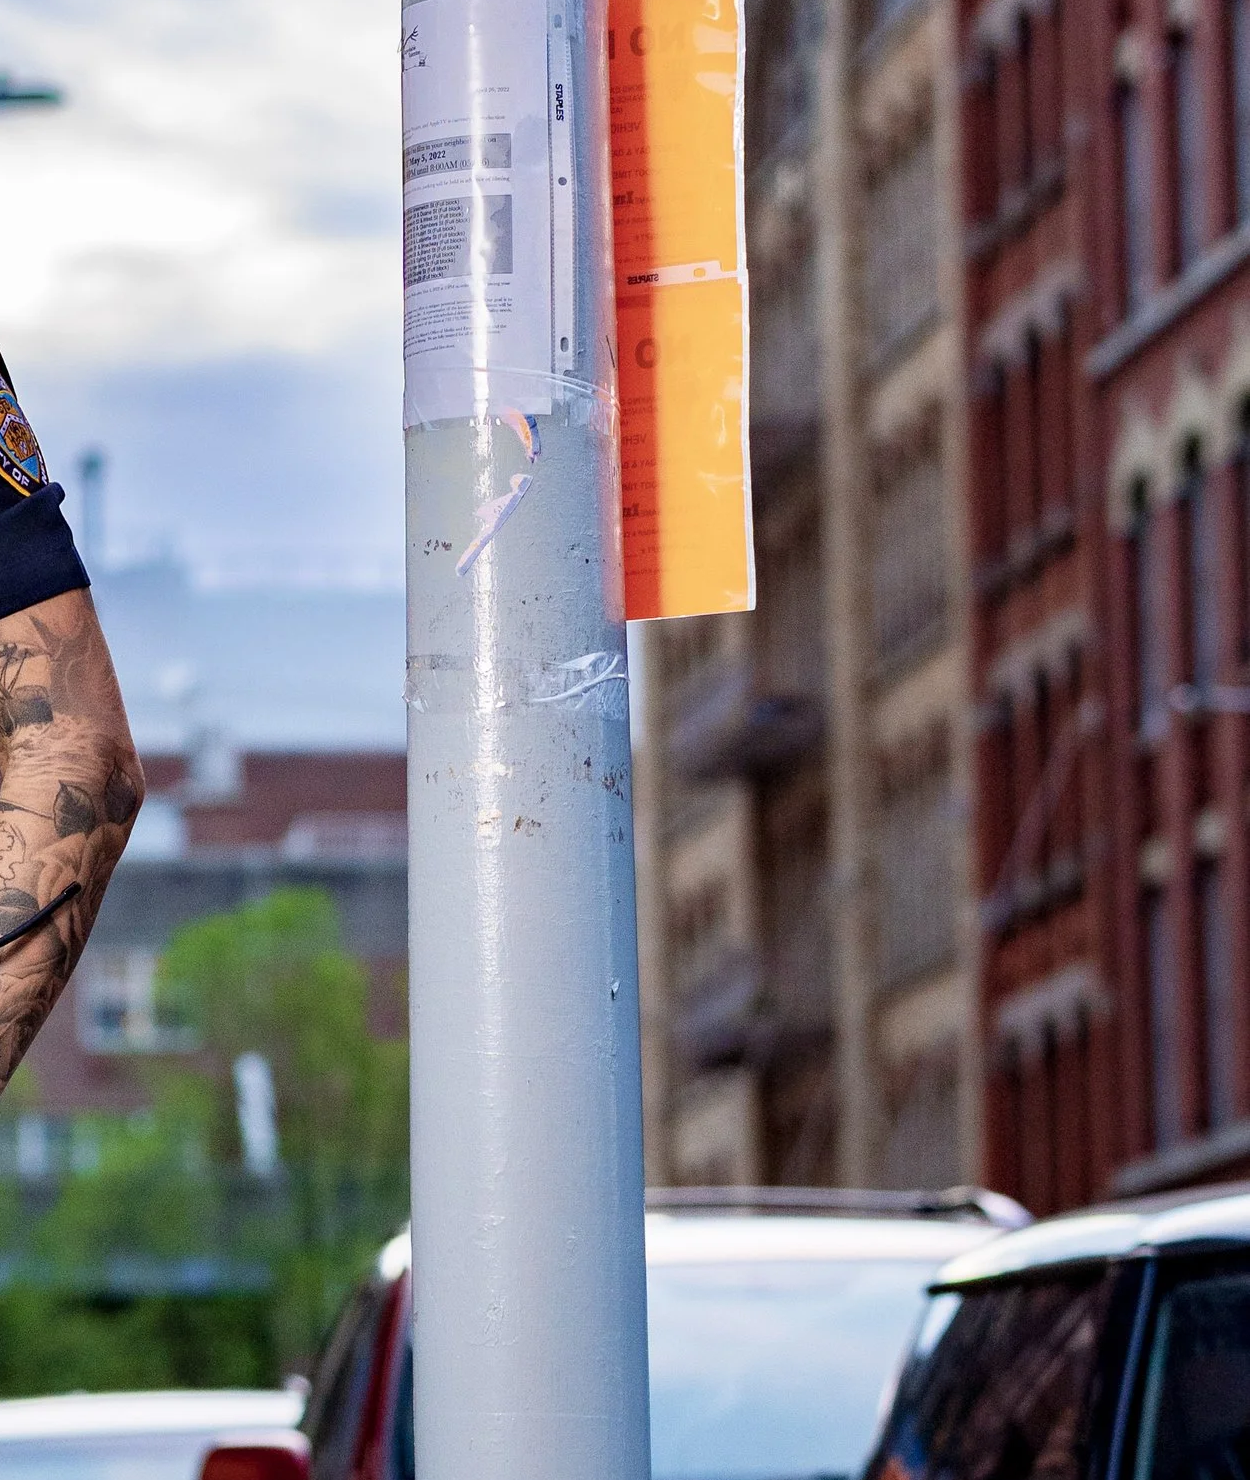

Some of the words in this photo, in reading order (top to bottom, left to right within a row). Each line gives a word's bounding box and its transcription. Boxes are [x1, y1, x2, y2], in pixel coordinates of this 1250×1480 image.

[555, 83, 564, 121] STAPLES
[429, 150, 446, 161] 2022
[430, 159, 458, 171] 8:00AM
[439, 212, 449, 220] (Full
[444, 219, 455, 227] (Full
[442, 225, 456, 233] block)
[437, 232, 448, 240] (Full
[448, 230, 465, 238] blocks)
[439, 239, 449, 247] (Full
[449, 237, 467, 245] blocks)
[436, 245, 446, 253] (Full
[11, 467, 30, 487] OF
